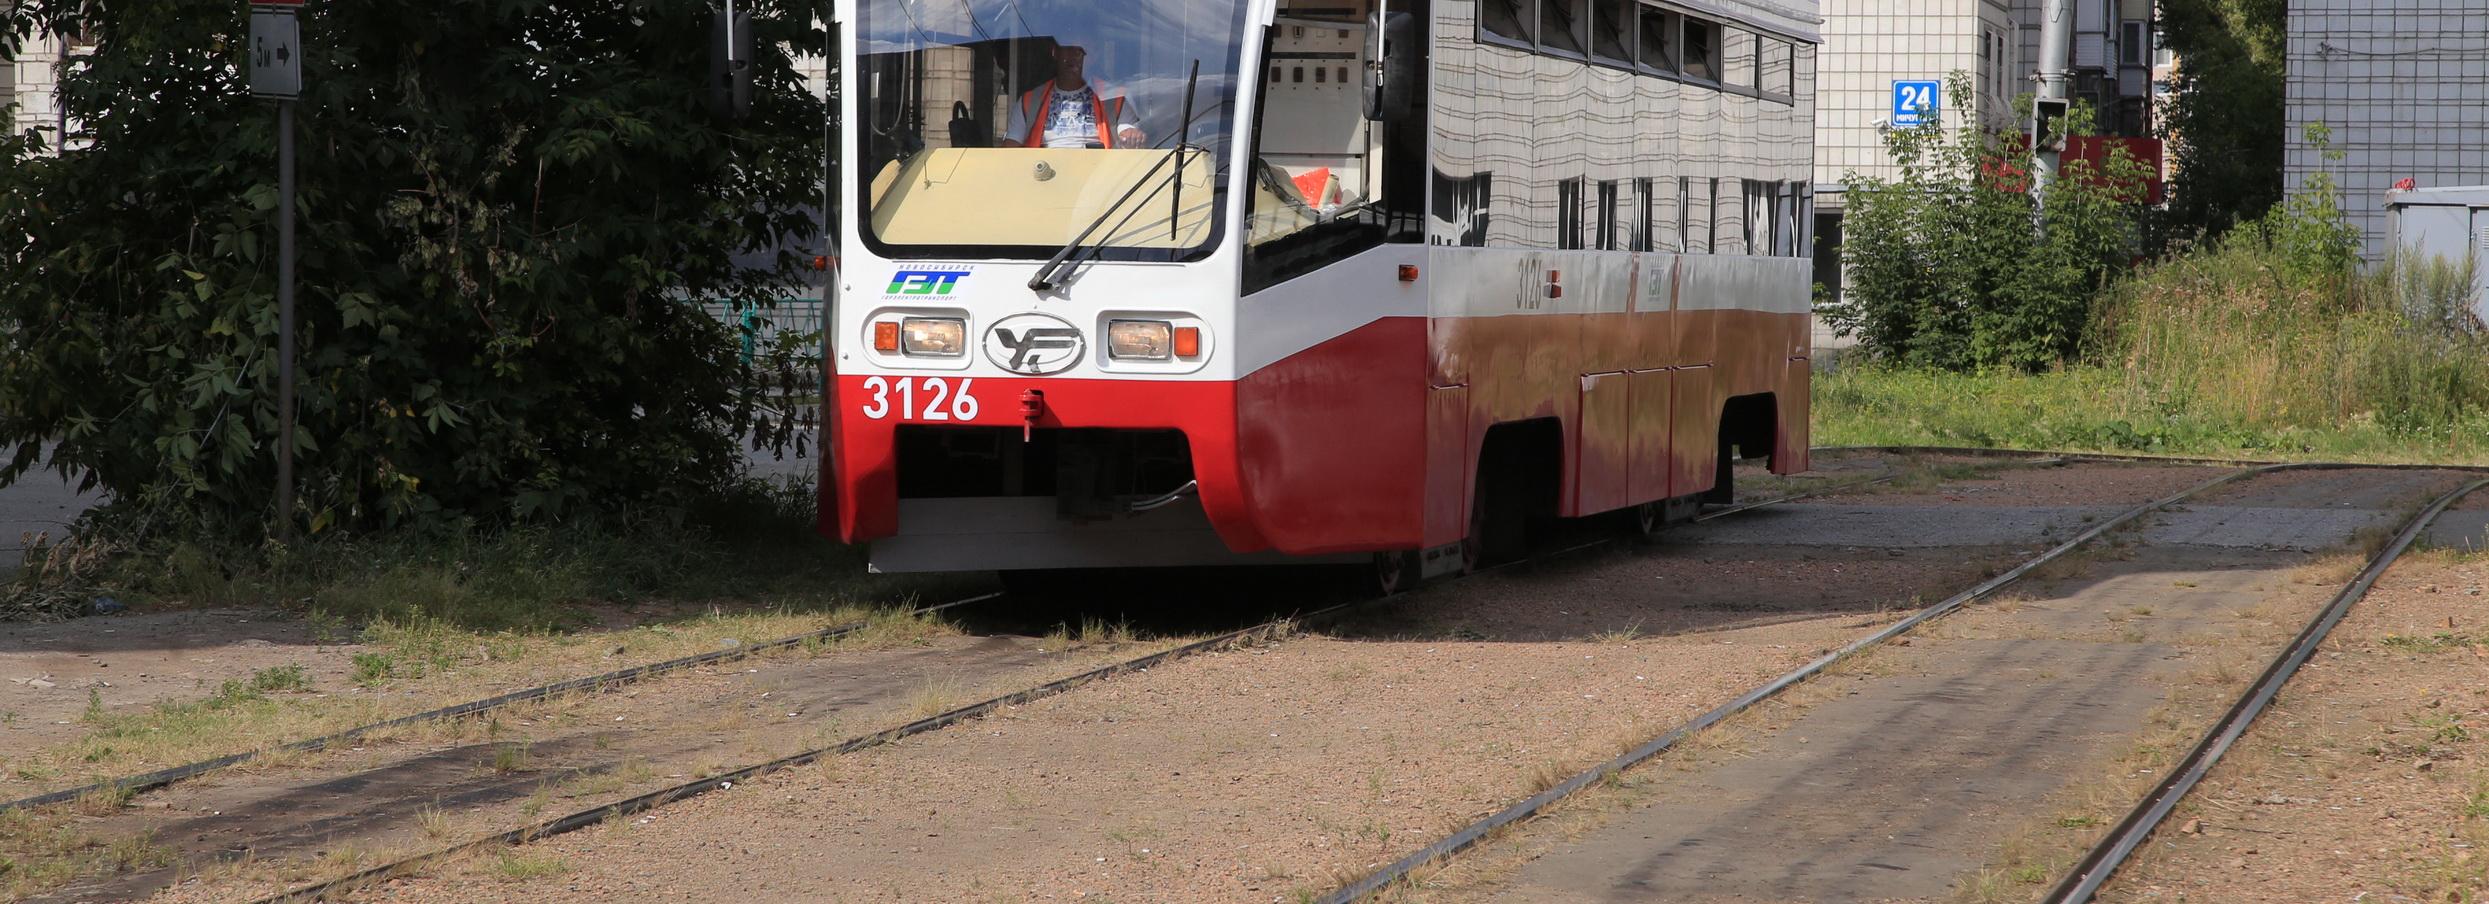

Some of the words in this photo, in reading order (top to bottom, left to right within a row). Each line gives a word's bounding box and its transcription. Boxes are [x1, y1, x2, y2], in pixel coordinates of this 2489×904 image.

[1901, 86, 1931, 111] 24
[899, 263, 975, 271] НОВОСИБИРСК
[1516, 257, 1542, 310] 3126
[862, 375, 979, 421] 3126
